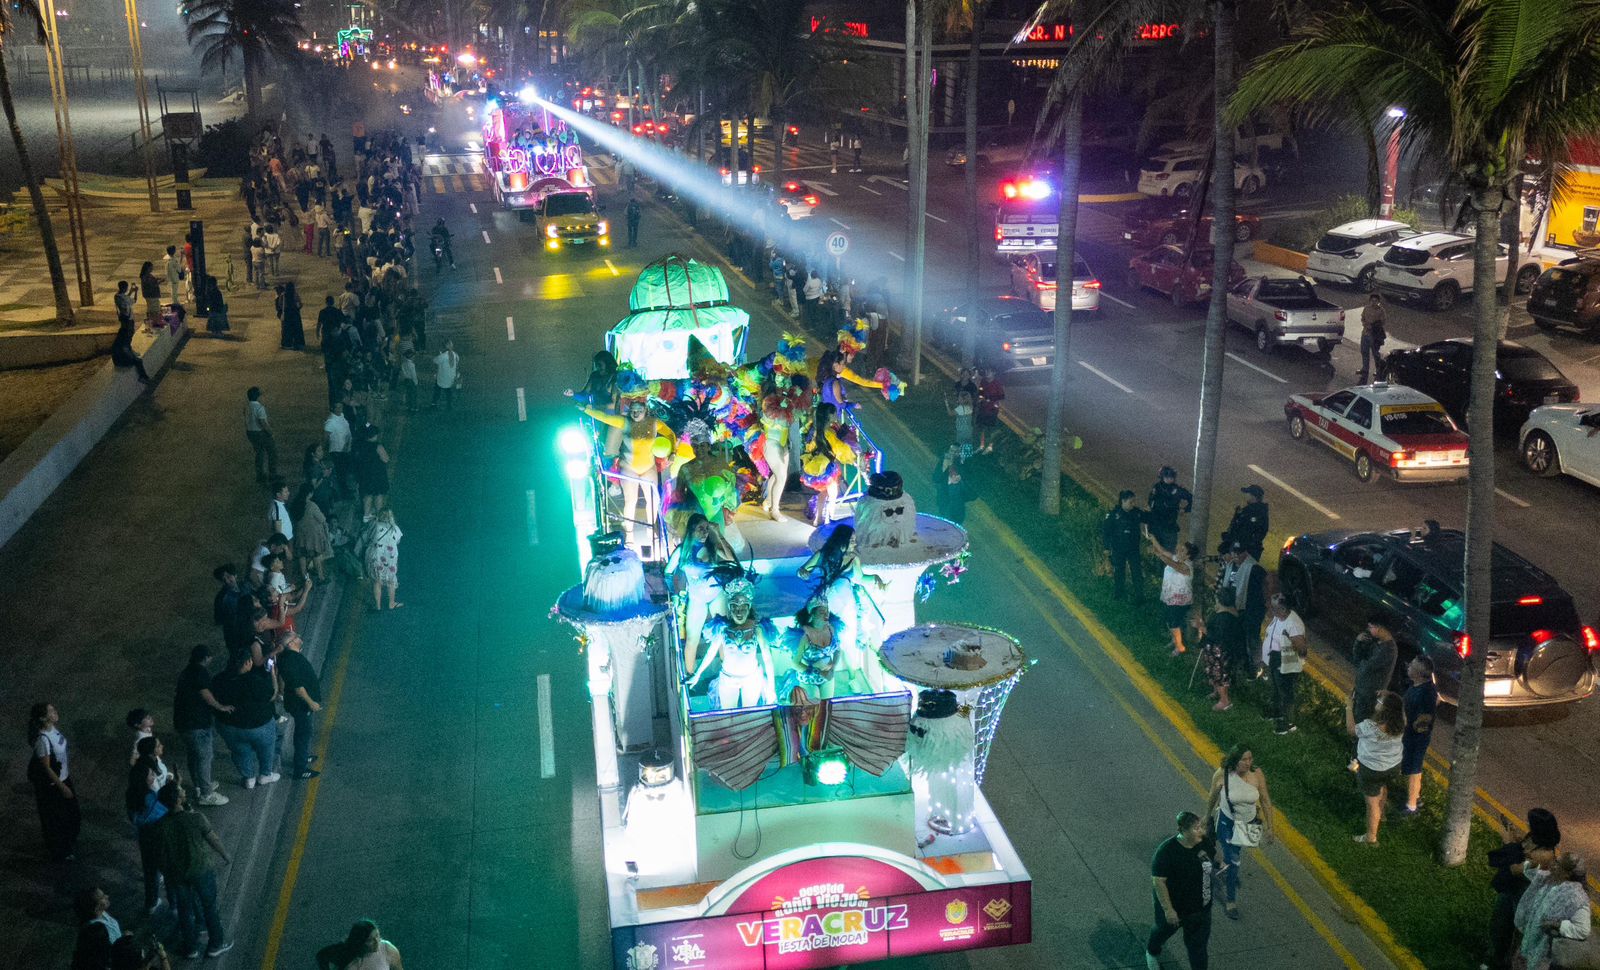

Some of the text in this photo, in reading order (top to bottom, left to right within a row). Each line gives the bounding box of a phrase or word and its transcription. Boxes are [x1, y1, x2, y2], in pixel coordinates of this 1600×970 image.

[832, 236, 846, 249] 40
[737, 904, 908, 946] VERACRUZ
[814, 936, 829, 948] DE
[831, 932, 867, 946] MODA!
[672, 943, 700, 954] VERA
